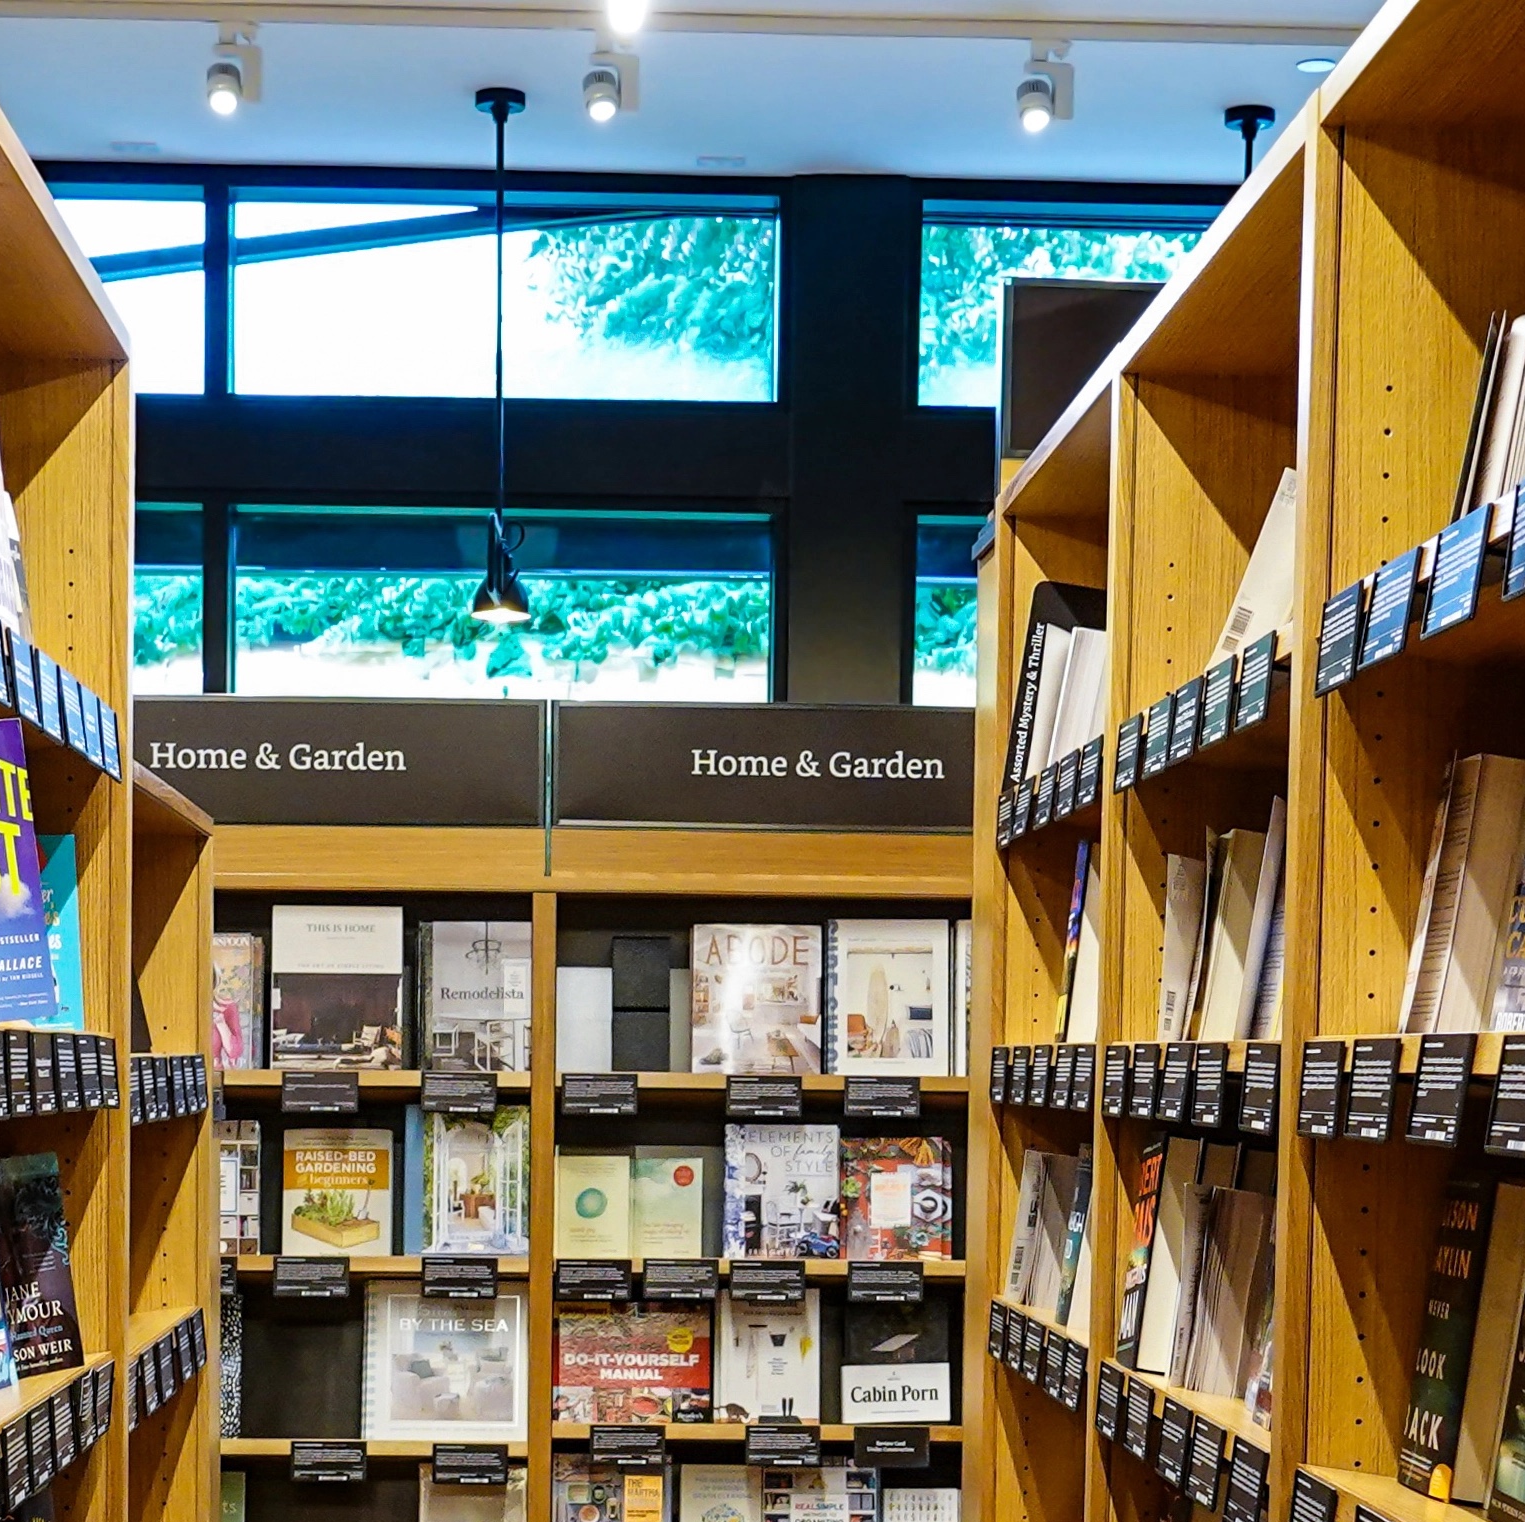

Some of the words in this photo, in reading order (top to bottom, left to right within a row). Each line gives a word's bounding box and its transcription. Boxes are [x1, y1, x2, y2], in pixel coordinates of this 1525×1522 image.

[1029, 622, 1045, 668] Thriller
[1026, 671, 1038, 680] &
[1018, 682, 1036, 729] Mystery
[149, 742, 246, 769] Home
[255, 743, 281, 770] &
[289, 742, 406, 771] Garden
[691, 749, 787, 777] Home
[795, 750, 822, 778] &
[829, 750, 945, 779] Garden
[1010, 731, 1027, 783] Assorted
[306, 923, 329, 933] THIS
[332, 923, 342, 933] IS
[344, 924, 376, 934] HOME
[705, 934, 811, 968] ABODE
[440, 985, 525, 1001] Remodelista
[295, 1150, 376, 1162] RAISED-BED
[295, 1162, 376, 1174] GARDENING
[309, 1173, 369, 1187] beginners
[399, 1317, 423, 1332] BY
[429, 1317, 465, 1332] THE
[471, 1318, 509, 1332] SEA
[563, 1353, 700, 1368] DO-IT-YOURSELF
[599, 1367, 663, 1381] MANUAL
[850, 1385, 898, 1403] Cabin
[900, 1385, 939, 1402] Porn
